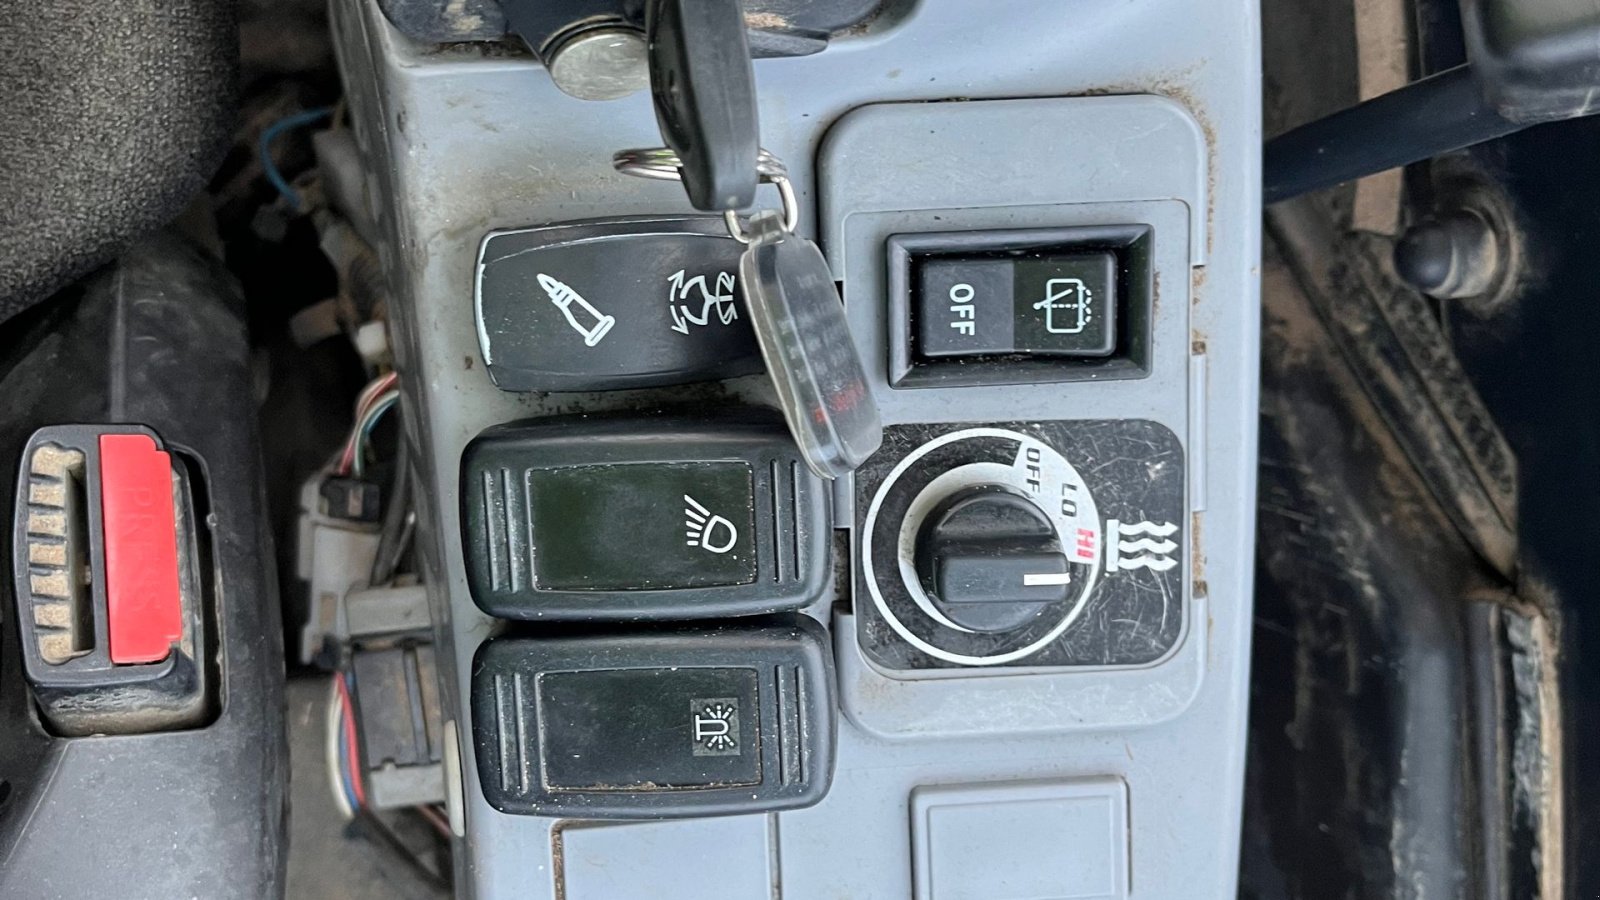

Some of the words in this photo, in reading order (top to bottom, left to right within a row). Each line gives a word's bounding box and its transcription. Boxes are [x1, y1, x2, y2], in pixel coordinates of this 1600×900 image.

[949, 283, 975, 336] OFF
[1026, 447, 1041, 493] OFF
[1062, 483, 1077, 517] LO
[120, 487, 162, 612] PRESS
[1077, 528, 1094, 559] HI
